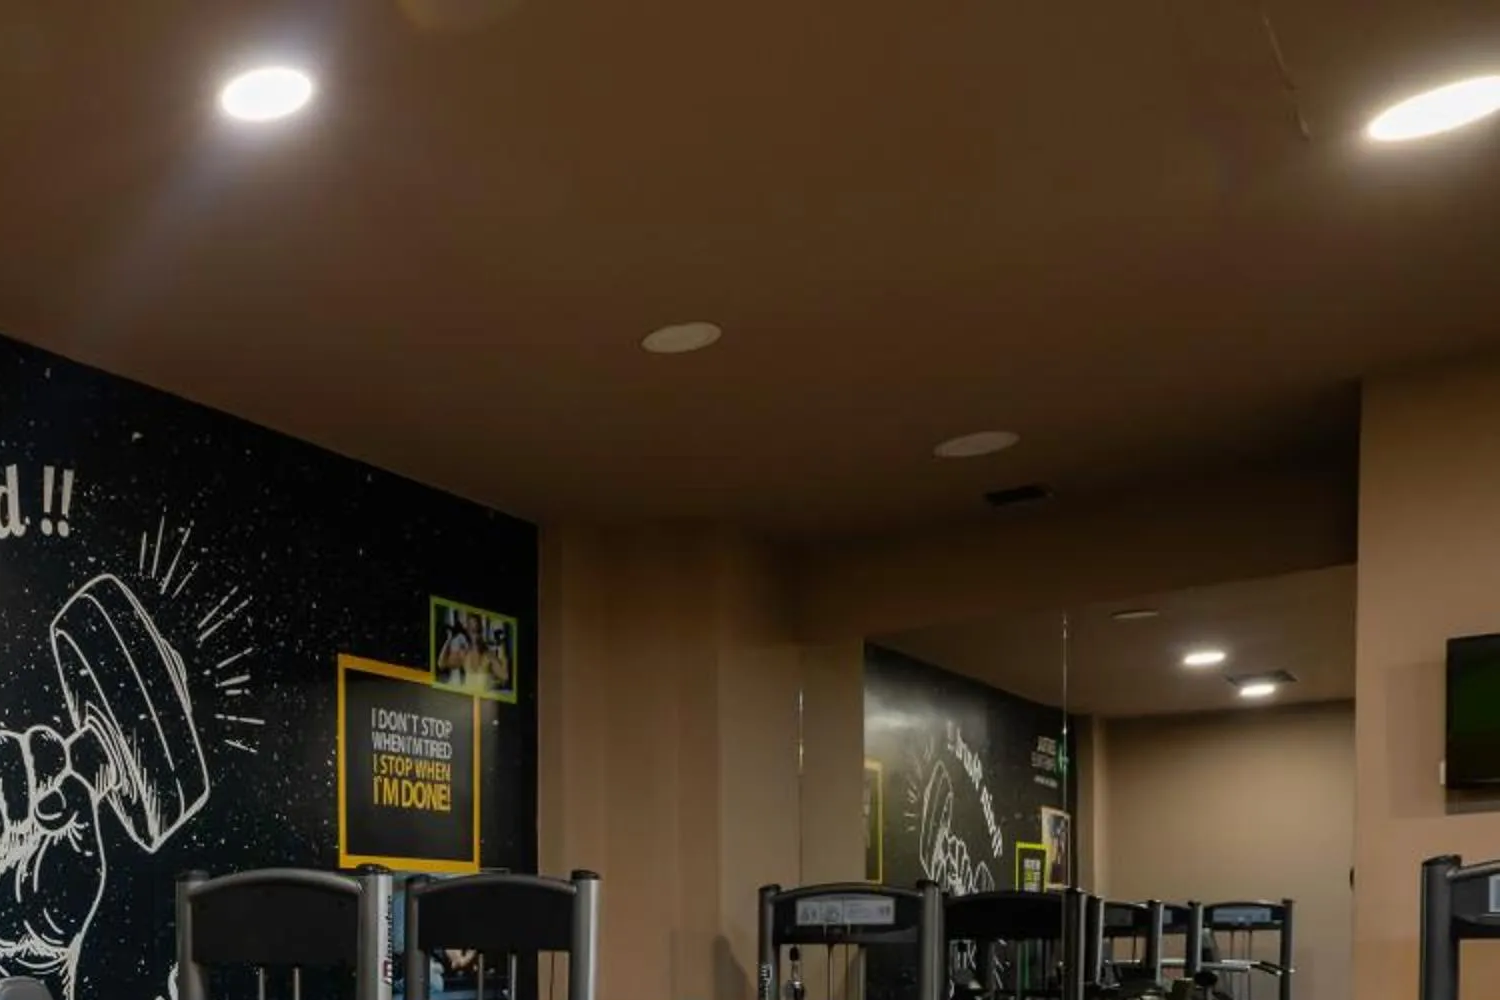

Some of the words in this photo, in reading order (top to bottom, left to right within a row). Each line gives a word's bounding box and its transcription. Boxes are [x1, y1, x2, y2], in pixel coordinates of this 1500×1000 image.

[378, 709, 419, 733] DON'T
[421, 716, 453, 739] STOP
[372, 731, 404, 753] WHEN
[380, 755, 412, 777] STOP
[415, 760, 451, 781] WHEN
